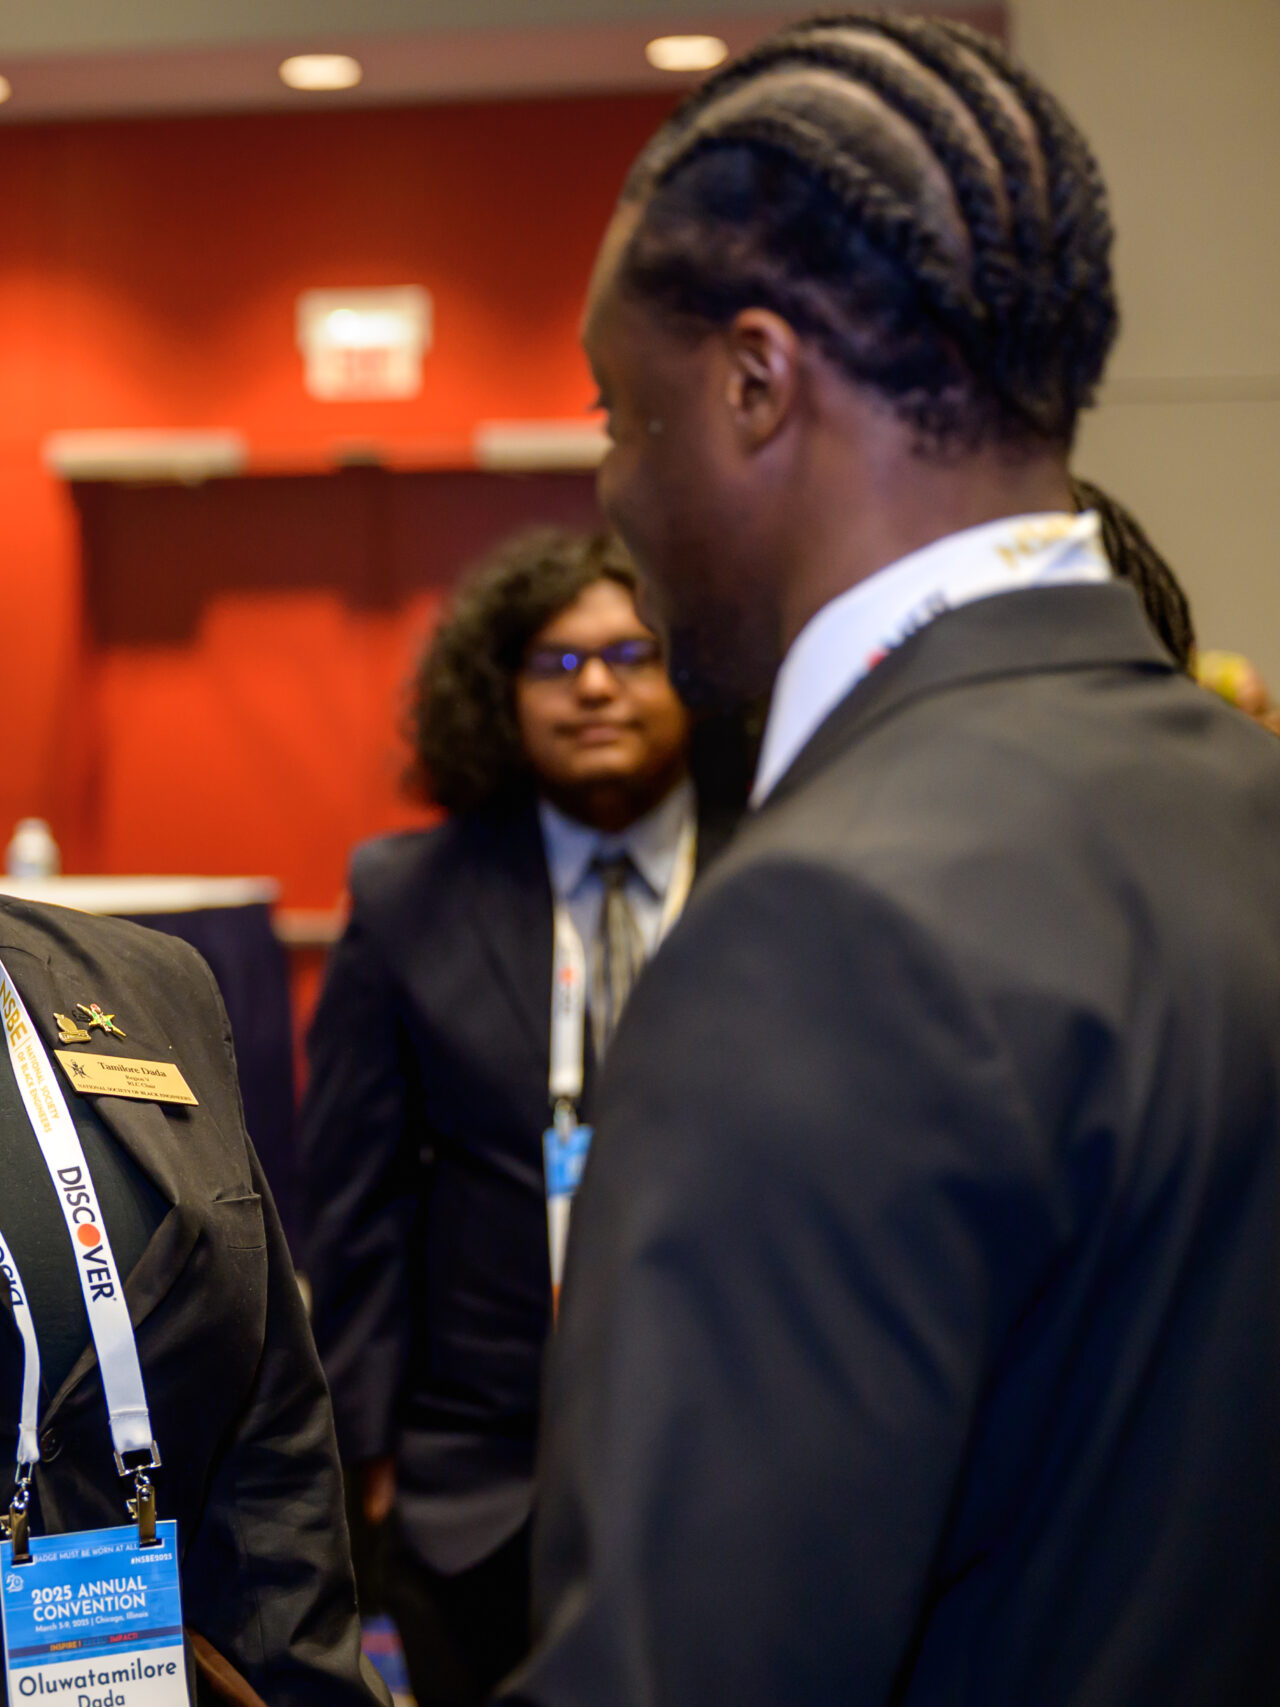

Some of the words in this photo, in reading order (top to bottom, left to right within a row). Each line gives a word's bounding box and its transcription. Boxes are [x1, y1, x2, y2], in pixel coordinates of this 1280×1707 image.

[0, 979, 28, 1047] NSBE
[17, 1051, 26, 1063] OF
[97, 1061, 140, 1075] Tamilore
[140, 1067, 167, 1078] Dada
[20, 1062, 35, 1088] BLACK
[25, 1044, 45, 1085] NATIONAL
[40, 1085, 60, 1119] SOCIETY
[30, 1087, 53, 1133] ENGINEERS
[57, 1166, 115, 1302] DISCOVER
[59, 1550, 79, 1560] MUST
[81, 1547, 90, 1557] BE
[92, 1545, 114, 1555] WORN
[115, 1543, 124, 1552] AT
[125, 1543, 138, 1551] ALL
[130, 1553, 173, 1565] #NSBE2025
[31, 1584, 72, 1605] 2025
[78, 1575, 147, 1598] ANNUAL
[33, 1592, 146, 1622] CONVENTION
[35, 1622, 58, 1632] March
[72, 1618, 90, 1628] 2025
[95, 1615, 124, 1624] Chicago,
[126, 1611, 149, 1620] Illinois
[18, 1657, 177, 1697] Oluwatamilore
[78, 1689, 126, 1707] Dada
